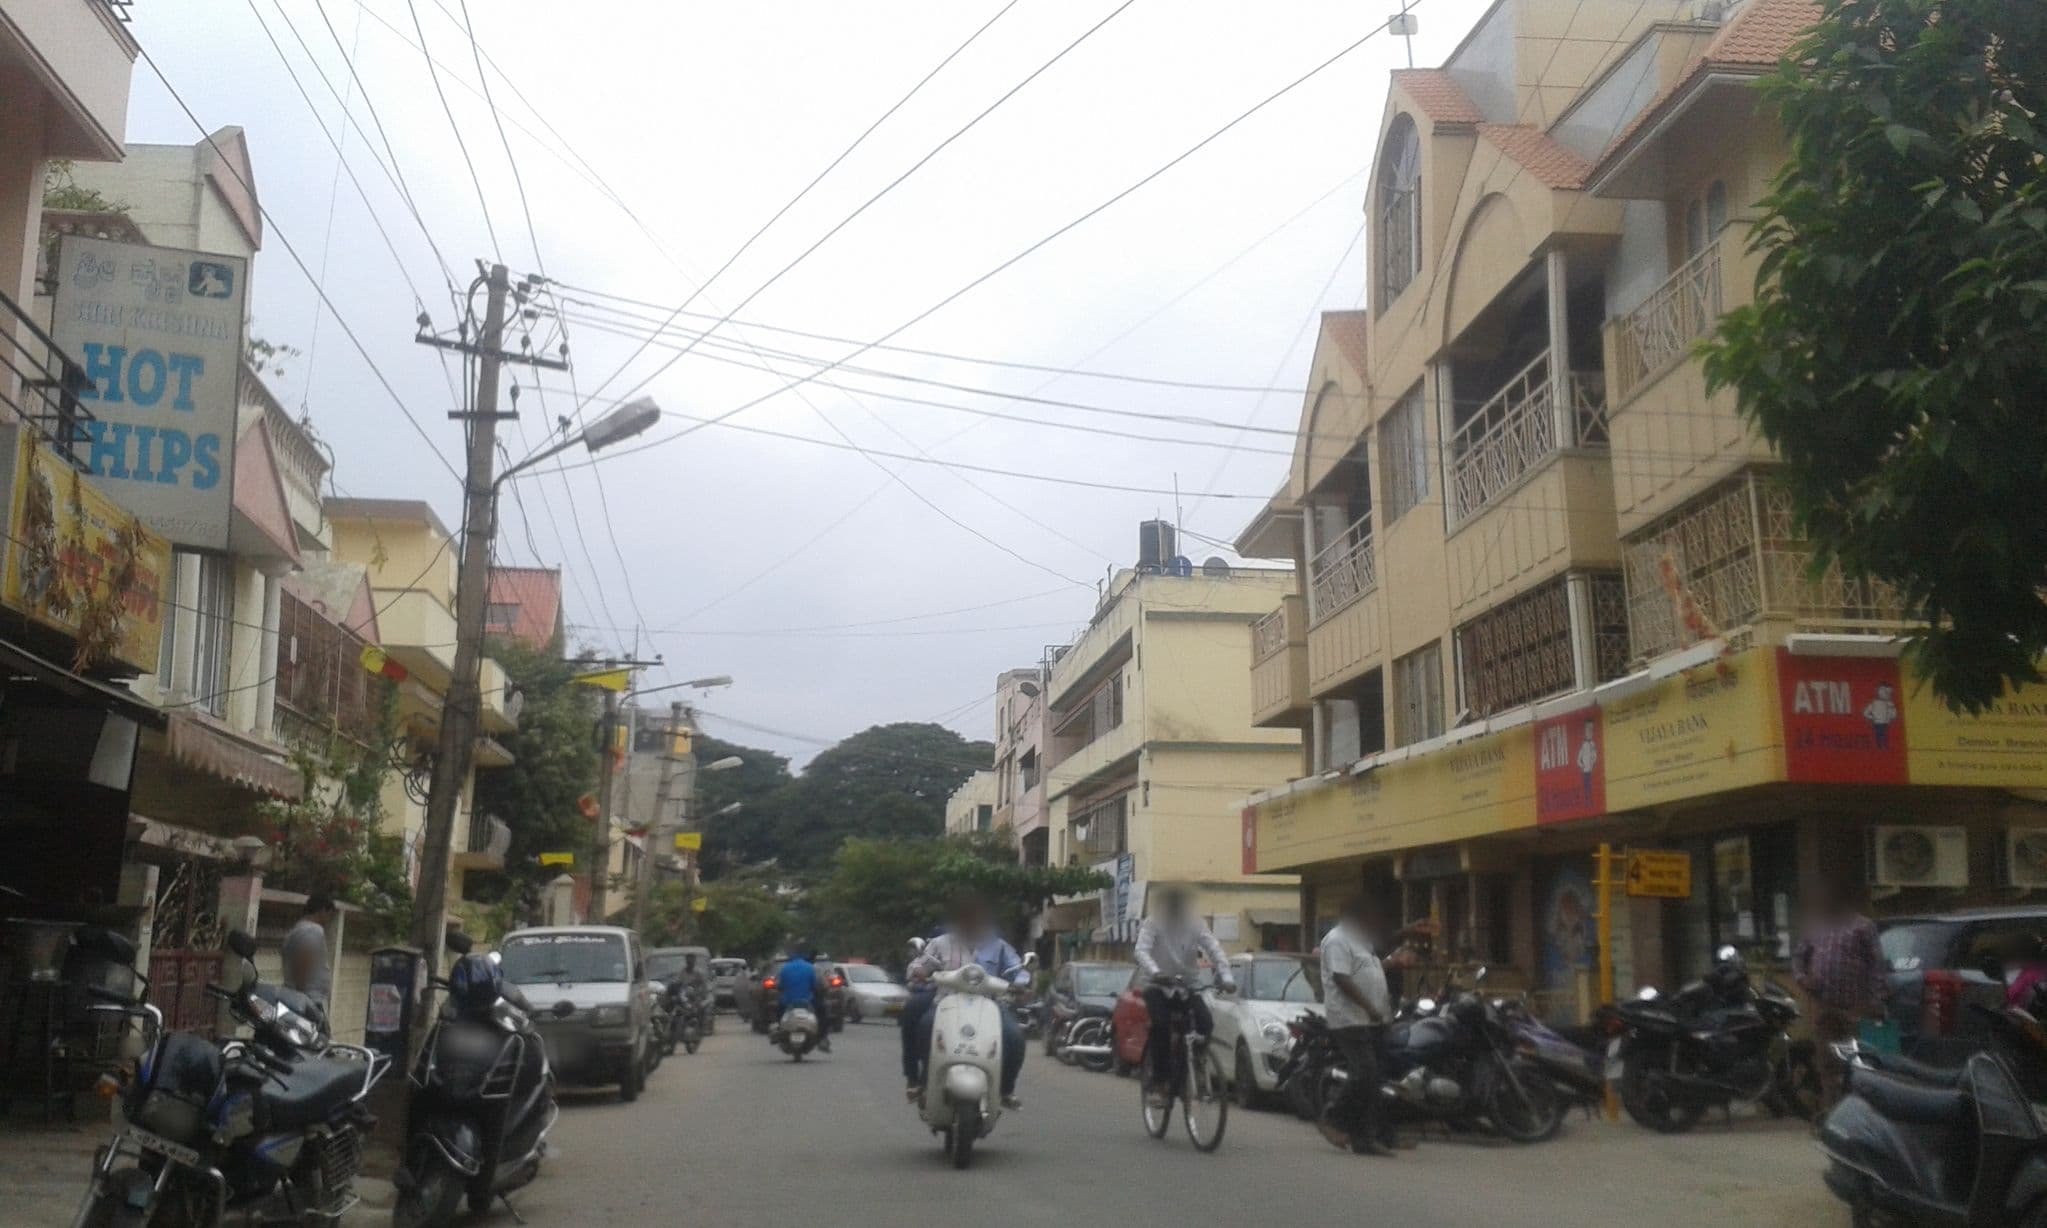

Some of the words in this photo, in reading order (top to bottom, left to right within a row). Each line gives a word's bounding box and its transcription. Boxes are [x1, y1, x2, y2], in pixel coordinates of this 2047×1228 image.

[79, 342, 205, 413] HOT
[1793, 680, 1852, 715] ATM
[1541, 723, 1568, 771] ATM
